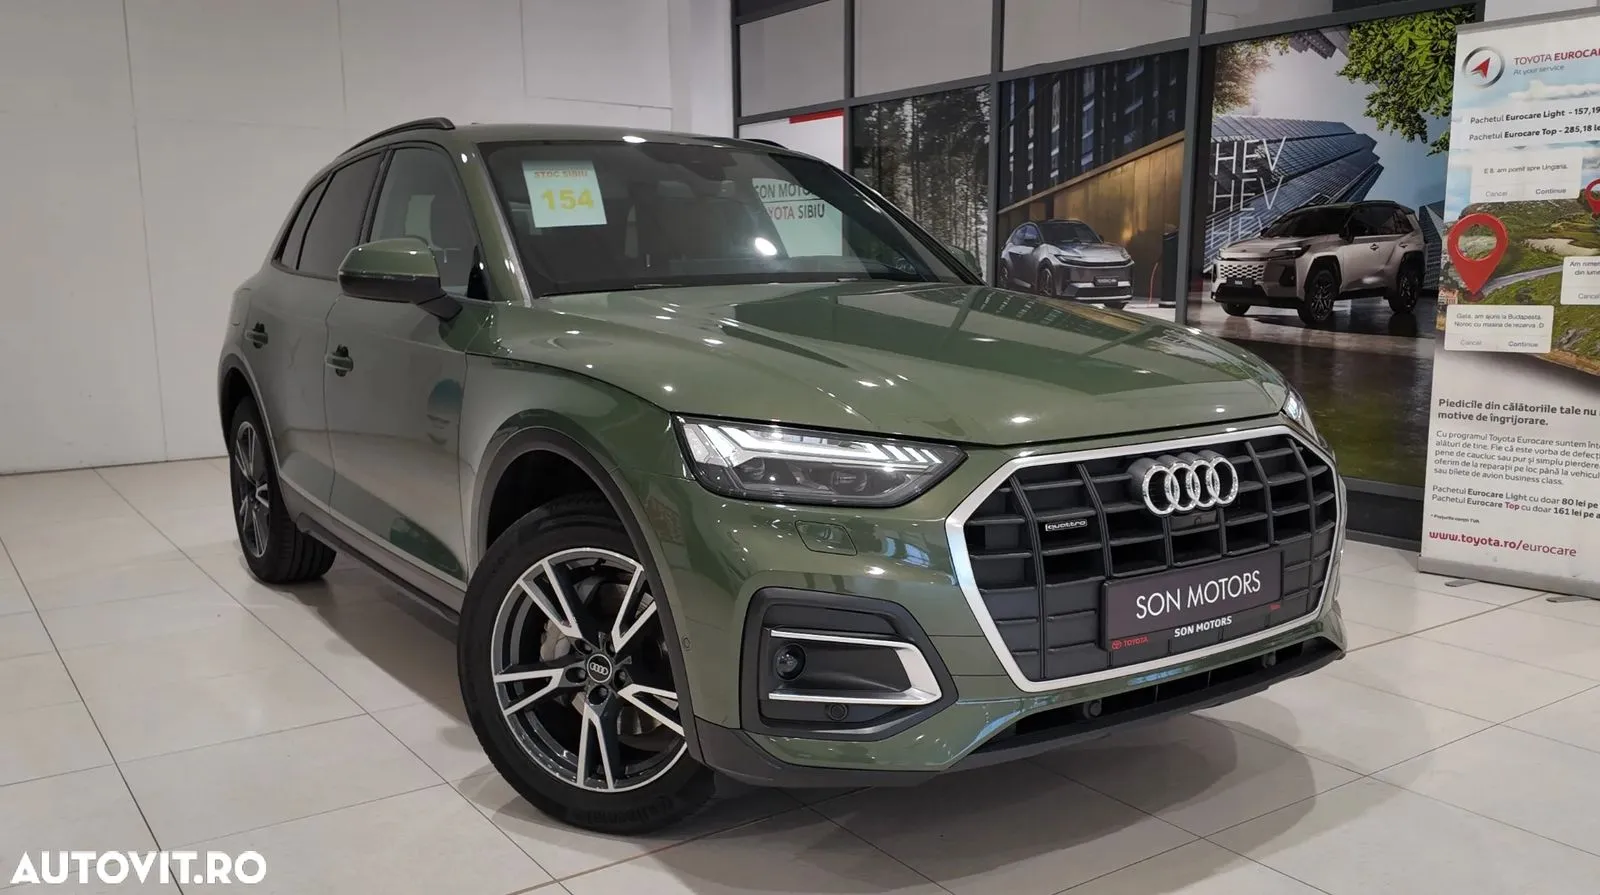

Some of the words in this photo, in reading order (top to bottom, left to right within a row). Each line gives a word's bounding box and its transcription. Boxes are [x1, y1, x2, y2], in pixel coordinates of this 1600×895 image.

[1514, 54, 1552, 66] TOYOTA
[1513, 68, 1522, 76] At
[1523, 67, 1538, 76] your
[1539, 64, 1565, 73] service
[1470, 115, 1504, 124] Pachetul
[1505, 112, 1542, 122] Eurocare
[1543, 109, 1565, 119] Light
[1469, 131, 1503, 141] Pachetul
[1504, 129, 1540, 139] Eurocare
[1541, 127, 1557, 137] Top
[1564, 124, 1592, 134] 285,18
[1214, 136, 1287, 175] HEV
[542, 186, 594, 211] 154
[778, 183, 811, 198] MOTO
[1212, 175, 1285, 213] HEV
[1535, 188, 1567, 196] Continue
[798, 203, 825, 219] SIBIU
[1508, 340, 1539, 348] Continue
[1438, 399, 1482, 409] Piedicile
[1485, 401, 1501, 410] din
[1502, 402, 1557, 414] călătoriile
[1560, 405, 1581, 415] tale
[1583, 408, 1597, 416] nu
[1438, 412, 1474, 420] motive
[1476, 413, 1488, 422] de
[1490, 413, 1549, 426] îngrijorare.
[1435, 439, 1460, 448] alături
[1462, 441, 1472, 449] de
[1490, 443, 1503, 451] Fie
[1515, 446, 1533, 454] este
[1534, 448, 1558, 456] vorba
[1560, 449, 1571, 457] de
[1436, 430, 1448, 438] Cu
[1448, 431, 1488, 441] programul
[1489, 433, 1516, 443] Toyota
[1517, 435, 1554, 445] Eurocare
[1555, 440, 1587, 448] suntem
[1588, 440, 1600, 450] înt
[1435, 449, 1455, 457] pene
[1456, 450, 1466, 458] de
[1467, 452, 1496, 460] cauciuc
[1497, 454, 1512, 462] sau
[1536, 457, 1563, 466] simplu
[1434, 458, 1460, 466] oferim
[1460, 459, 1471, 467] de
[1513, 465, 1524, 473] pe
[1526, 465, 1538, 474] loc
[1539, 467, 1560, 476] până
[1561, 468, 1569, 476] la
[1448, 468, 1470, 477] bilete
[1471, 470, 1481, 478] de
[1482, 471, 1504, 479] avion
[1505, 473, 1540, 483] business
[1432, 484, 1466, 494] Pachetul
[1467, 488, 1504, 498] Eurocare
[1505, 491, 1527, 502] Light
[1528, 495, 1539, 503] cu
[1540, 496, 1560, 504] doar
[1561, 497, 1574, 506] 80
[1575, 499, 1586, 507] lei
[1587, 502, 1599, 510] pe
[1431, 494, 1466, 504] Pachetul
[1466, 497, 1503, 508] Eurocare
[1504, 501, 1520, 511] Top
[1521, 504, 1531, 512] cu
[1532, 505, 1552, 513] doar
[1553, 507, 1570, 516] 161
[1571, 508, 1582, 517] lei
[1583, 511, 1595, 519] pe
[1046, 520, 1087, 531] quattro
[1429, 531, 1577, 557] www.toyota.ro/eurocare
[1136, 588, 1181, 619] SON
[1187, 570, 1262, 608] MOTORS
[1174, 623, 1195, 638] SON
[1196, 615, 1233, 633] MOTORS
[1123, 635, 1149, 648] TOYOTA
